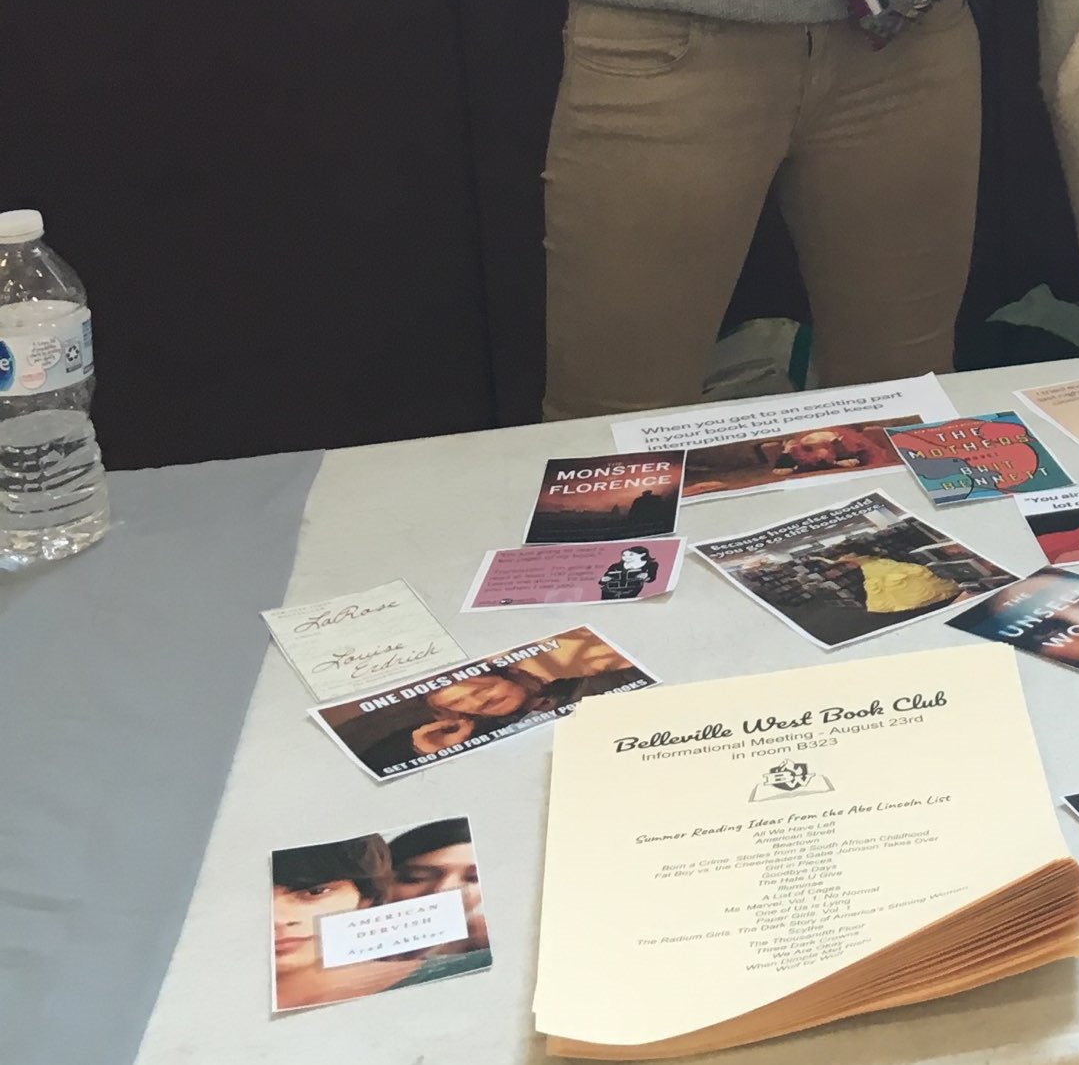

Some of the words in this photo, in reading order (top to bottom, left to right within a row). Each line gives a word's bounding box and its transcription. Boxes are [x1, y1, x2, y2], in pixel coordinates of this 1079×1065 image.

[641, 423, 692, 436] When
[695, 417, 725, 429] you
[729, 411, 758, 424] get
[760, 410, 777, 418] to
[780, 407, 800, 415] an
[803, 397, 868, 412] exciting
[870, 391, 903, 403] part
[644, 435, 660, 444] in
[662, 430, 703, 443] your
[704, 423, 749, 435] book
[751, 417, 780, 427] but
[782, 408, 841, 424] people
[843, 402, 884, 415] keep
[647, 431, 748, 452] interrupting
[750, 426, 782, 438] you
[907, 434, 1032, 460] MOTHERS
[935, 426, 984, 443] THE
[556, 461, 671, 482] MONSTER
[548, 474, 673, 496] FLORENCE
[1024, 494, 1060, 504] "You
[1052, 501, 1073, 510] lot
[709, 533, 768, 552] Because
[769, 523, 800, 538] how
[802, 514, 829, 530] else
[830, 497, 874, 517] would
[1003, 591, 1032, 608] THE
[311, 640, 405, 675] Louise
[359, 692, 402, 714] ONE
[402, 675, 454, 700] DOES
[453, 660, 493, 687] NOT
[493, 638, 562, 670] SIMPLY
[613, 722, 734, 754] Belleville
[742, 711, 815, 736] West
[819, 699, 886, 725] Book
[892, 690, 949, 712] Club
[381, 760, 408, 775] GET
[408, 751, 438, 768] TOO
[438, 742, 465, 760] OLD
[464, 734, 492, 752] FOR
[491, 726, 517, 743] THE
[641, 739, 747, 763] Informational
[750, 729, 815, 749] Meeting
[828, 719, 886, 738] August
[888, 714, 925, 728] 23rd
[731, 750, 746, 762] in
[750, 746, 793, 759] room
[796, 737, 840, 752] B323
[635, 830, 688, 845] Summer
[691, 821, 743, 839] Reading
[747, 815, 785, 830] Ideas
[822, 807, 845, 819] the
[847, 804, 875, 816] Abe
[876, 797, 923, 813] Lincoln
[926, 792, 953, 806] List
[755, 834, 803, 846] American
[805, 828, 836, 837] Street
[811, 863, 838, 874] Days
[347, 903, 440, 929] AMERICAN
[356, 916, 433, 939] DERVISH
